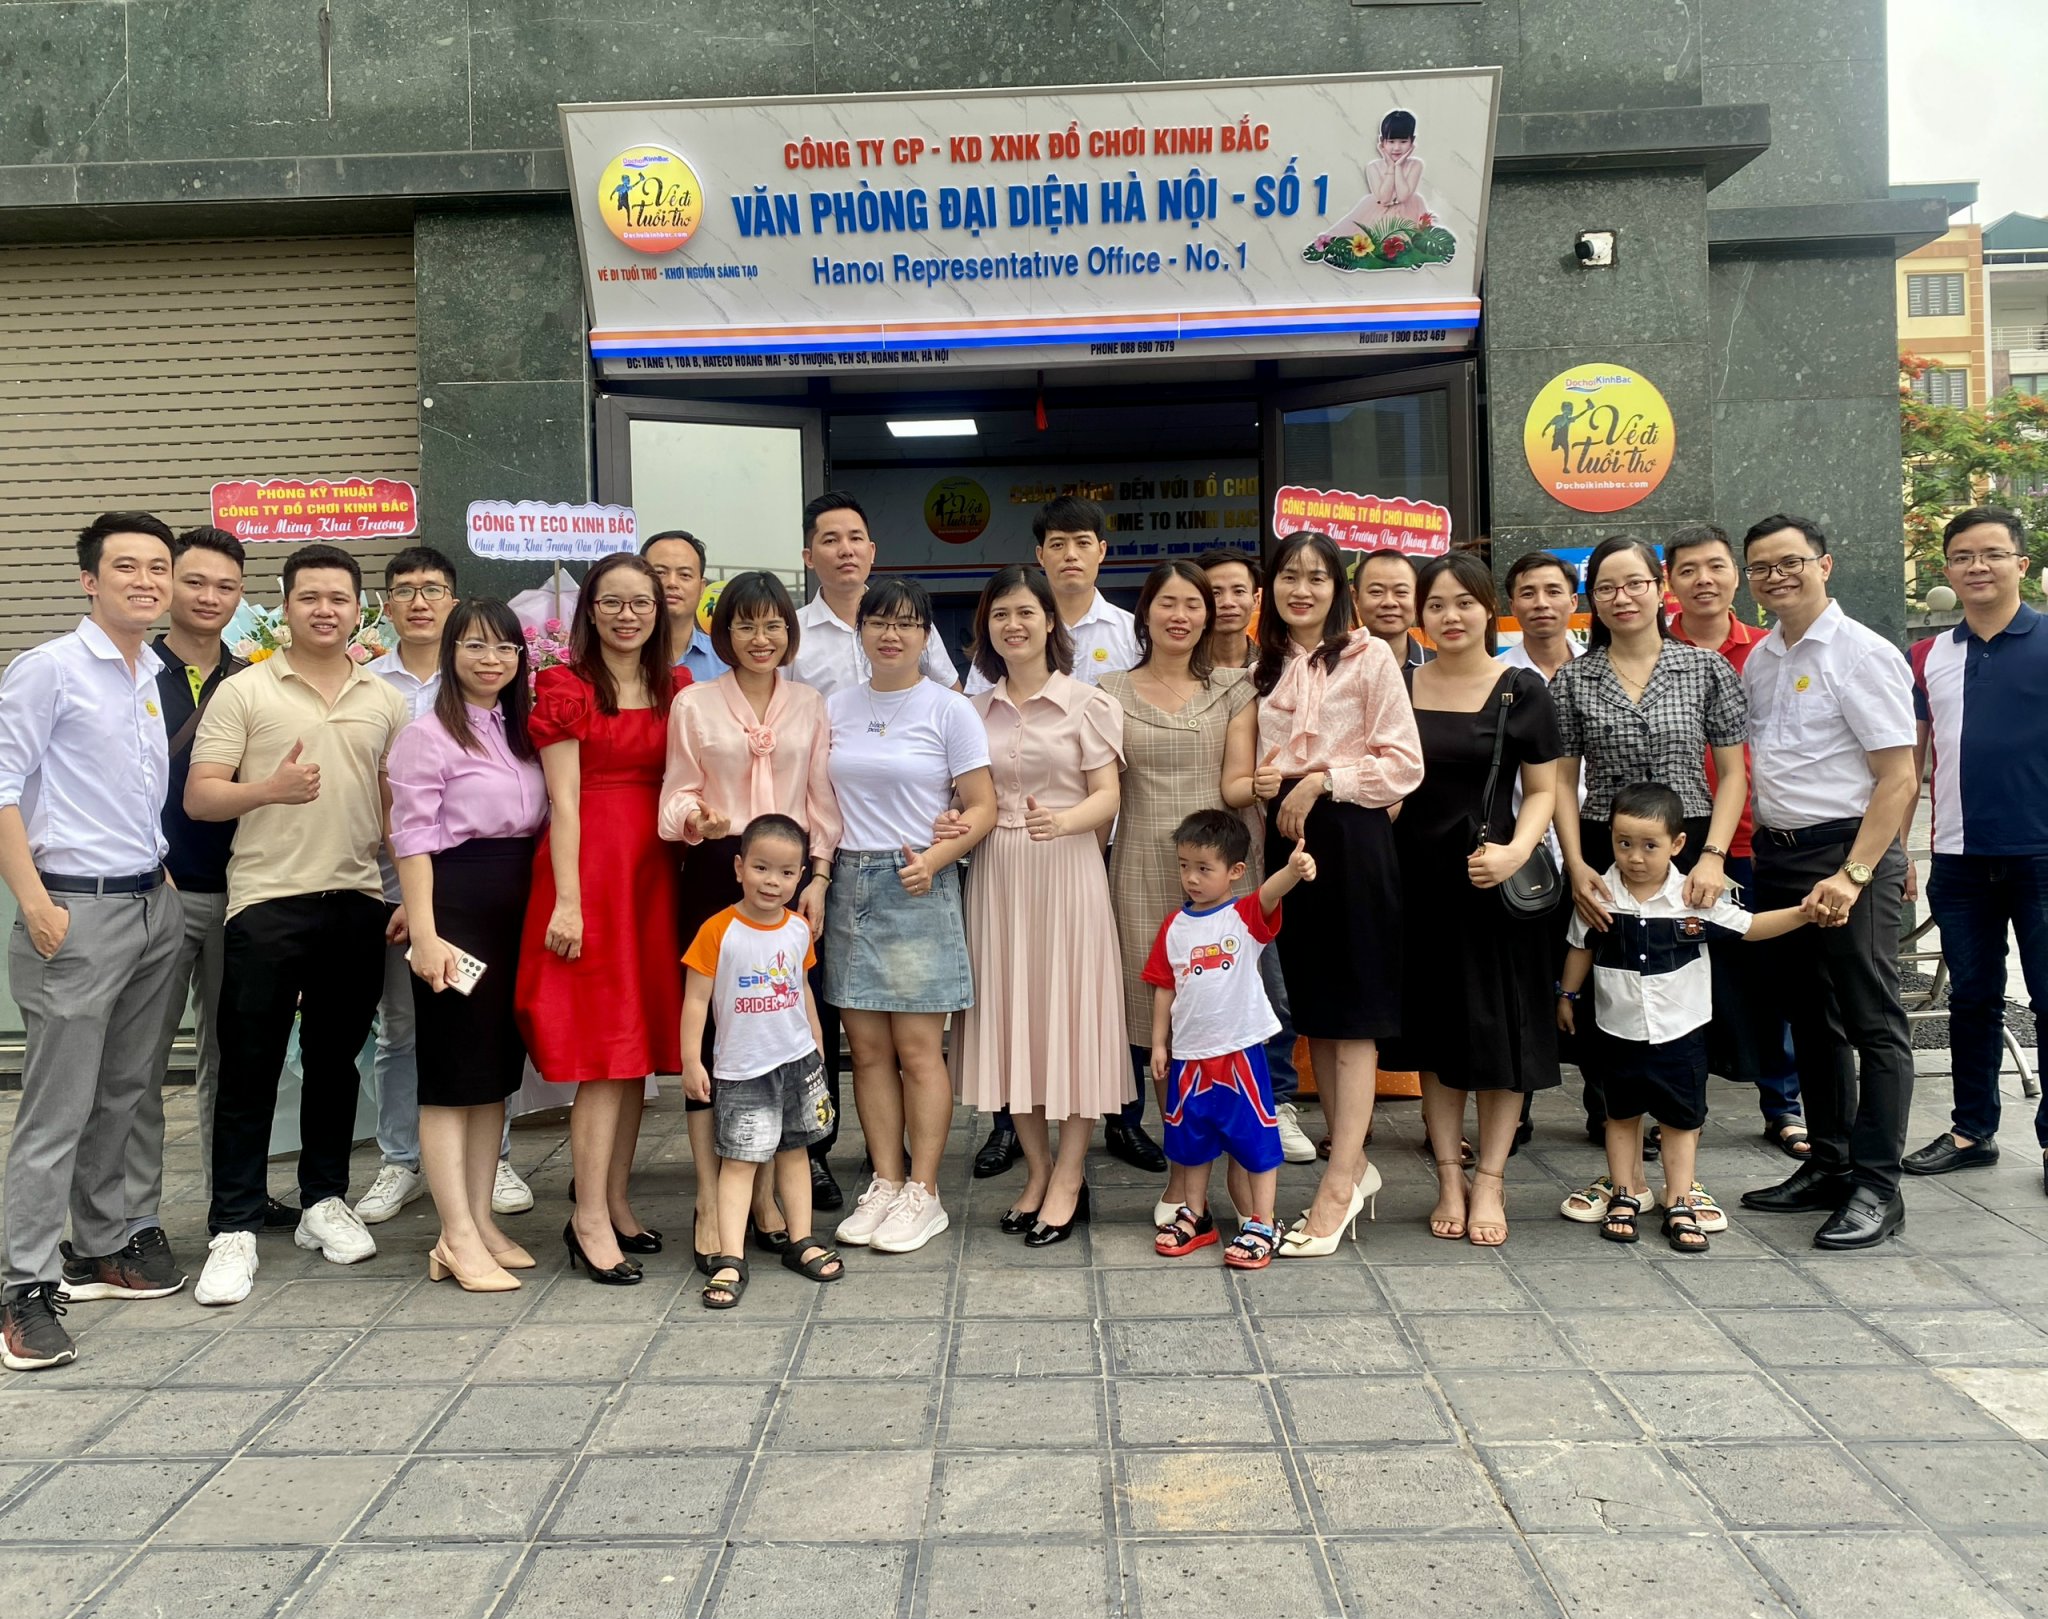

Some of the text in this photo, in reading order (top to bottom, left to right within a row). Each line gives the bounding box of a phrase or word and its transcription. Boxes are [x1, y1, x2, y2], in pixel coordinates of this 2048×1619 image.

[784, 136, 850, 170] CÔNG
[856, 139, 885, 166] TY
[893, 138, 924, 165] CP
[950, 136, 982, 163] KD
[990, 134, 1041, 161] XNK
[1049, 121, 1081, 159] ĐỒ
[1089, 127, 1146, 157] CHƠI
[1154, 126, 1213, 155] KINH
[1221, 114, 1270, 153] BẮC
[731, 185, 801, 237] VĂN
[810, 180, 929, 234] PHÒNG
[939, 186, 997, 238] ĐẠI
[1008, 174, 1089, 235] DIỆN
[1101, 170, 1147, 223] HÀ
[1158, 168, 1218, 228] NỘI
[1254, 156, 1300, 217] SỐ
[1314, 175, 1328, 216] 1
[743, 265, 759, 280] TẠO
[813, 256, 884, 284] Hanoi
[893, 252, 1078, 288] Representative
[1088, 246, 1161, 275] Office
[1186, 243, 1229, 271] No.
[1237, 242, 1247, 269] 1
[1391, 331, 1411, 343] 1900
[1430, 329, 1446, 341] 469
[1090, 342, 1119, 355] PHONE
[1120, 341, 1135, 354] 088
[703, 354, 733, 368] HATECO
[765, 354, 781, 366] MAI
[1565, 375, 1632, 387] DochoiKinhBac
[257, 485, 375, 500] PHÒNG KỸ THUẬT
[1119, 474, 1149, 500] ĐẾN
[1159, 474, 1189, 499] VỚI
[1555, 480, 1649, 490] Dochoikinhbac.com
[219, 504, 259, 518] CÔNG
[264, 505, 279, 516] TY
[307, 502, 340, 515] CHƠI
[344, 501, 377, 514] KINH
[1282, 496, 1306, 516] CÔNG
[1307, 500, 1330, 518] ĐOÀN
[1333, 502, 1356, 521] CÔNG
[1358, 506, 1369, 522] TY
[1384, 508, 1402, 526] CHƠI
[1404, 511, 1424, 528] KINH
[236, 516, 405, 536] Chúc Mừng Khai Trương
[472, 511, 634, 534] CÔNG TY ECO KINH BẮC
[1150, 512, 1171, 531] TO
[1176, 510, 1219, 530] KINH
[1327, 522, 1347, 541] Khai
[524, 538, 543, 552] Khai
